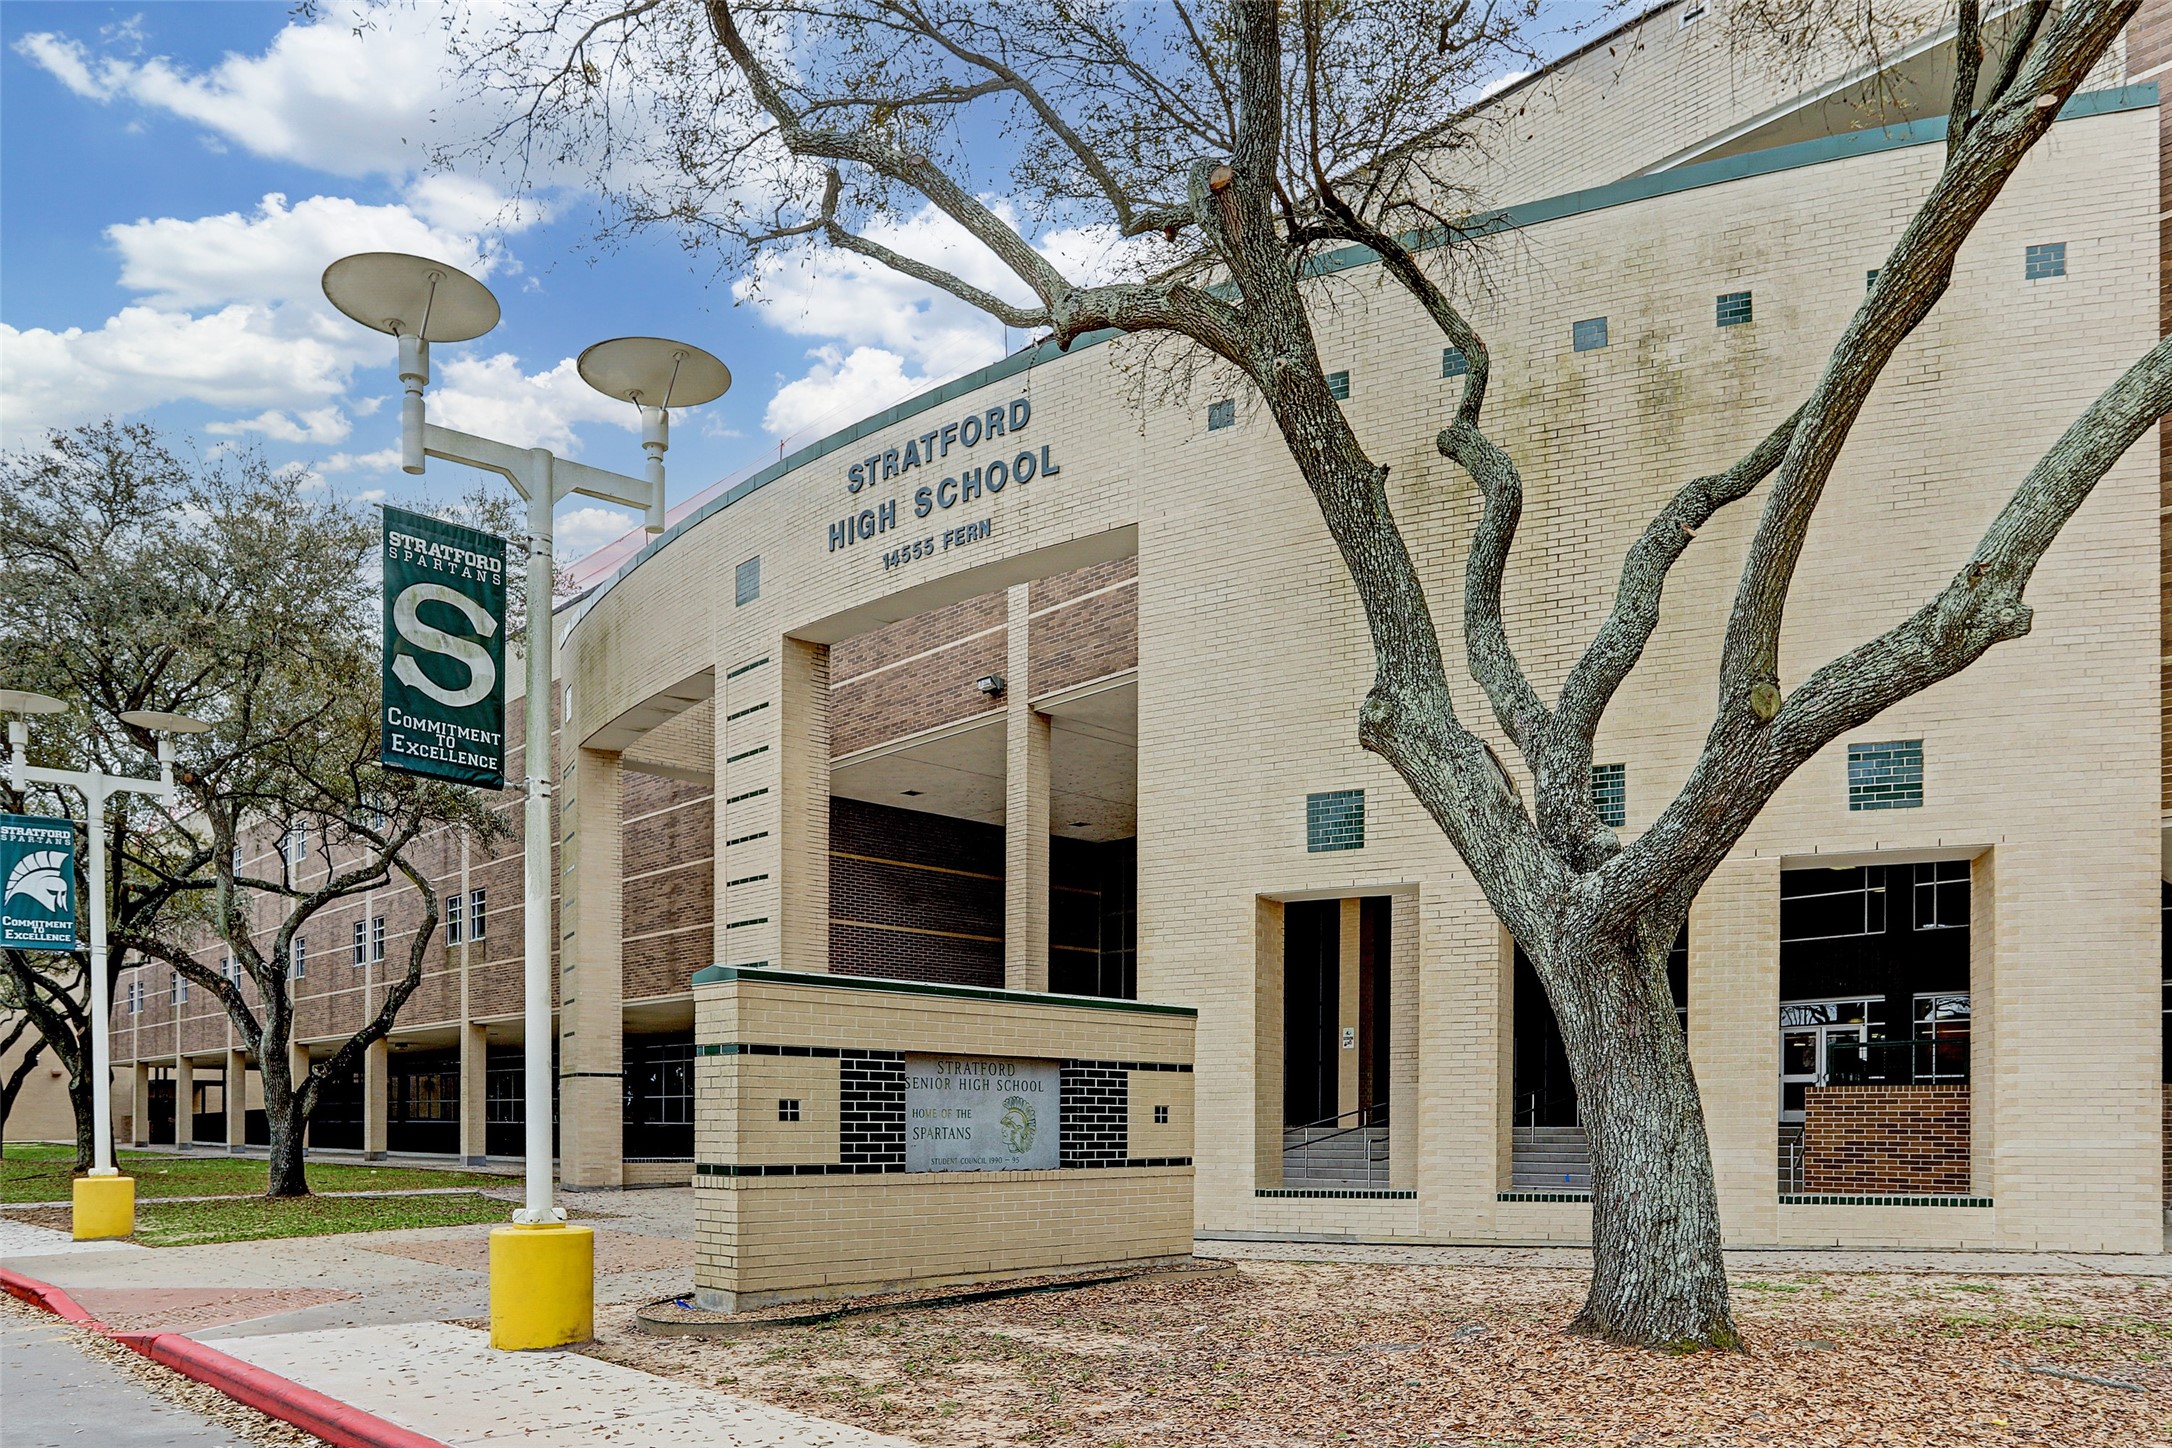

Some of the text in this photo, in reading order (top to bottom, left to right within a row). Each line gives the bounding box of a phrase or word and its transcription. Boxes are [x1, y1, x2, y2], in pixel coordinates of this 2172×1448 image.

[848, 398, 1031, 493] STRATFORD
[828, 444, 1060, 552] HIGH SCHOOL
[388, 530, 502, 573] STRATFORD
[882, 518, 991, 570] 14555 FERN
[388, 546, 502, 585] SPARTANS
[391, 582, 498, 708] S
[388, 707, 501, 745] COMMITMENT
[436, 733, 456, 749] TO
[391, 733, 498, 770] EXCELLENCE
[0, 826, 70, 839] STRATFORD
[0, 834, 71, 845] SPARTANS
[2, 915, 72, 929] COMMITMENT
[5, 929, 71, 941] EXCELLENCE
[937, 1060, 1016, 1076] STRATFORD
[905, 1077, 1044, 1092] SENIOR HIGH SCHOOL
[912, 1109, 972, 1119] HOME OF THE
[912, 1127, 971, 1140] SPARTANS
[931, 1157, 958, 1165] STUDENT
[960, 1157, 987, 1165] COUNCIL
